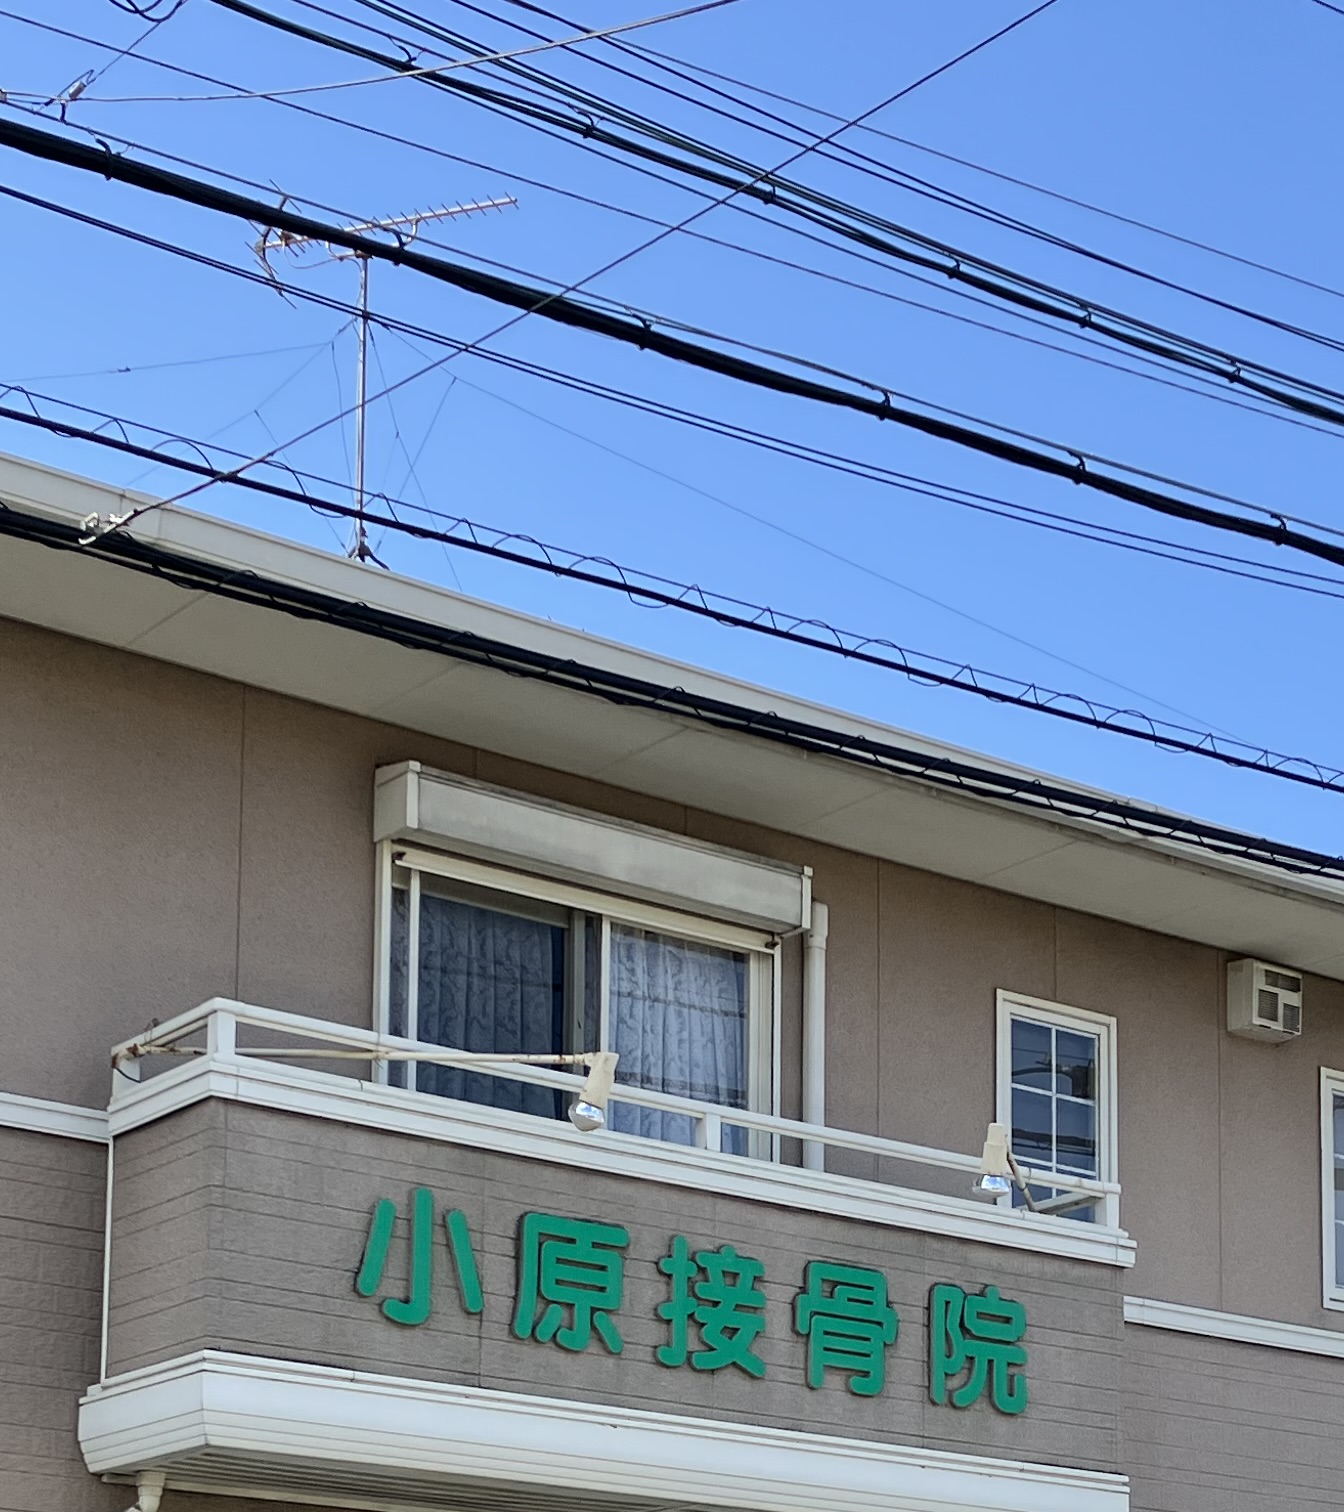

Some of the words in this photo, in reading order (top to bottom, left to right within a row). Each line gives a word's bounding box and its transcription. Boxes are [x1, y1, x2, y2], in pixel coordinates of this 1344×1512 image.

[356, 1187, 1027, 1414] 小原接骨院
